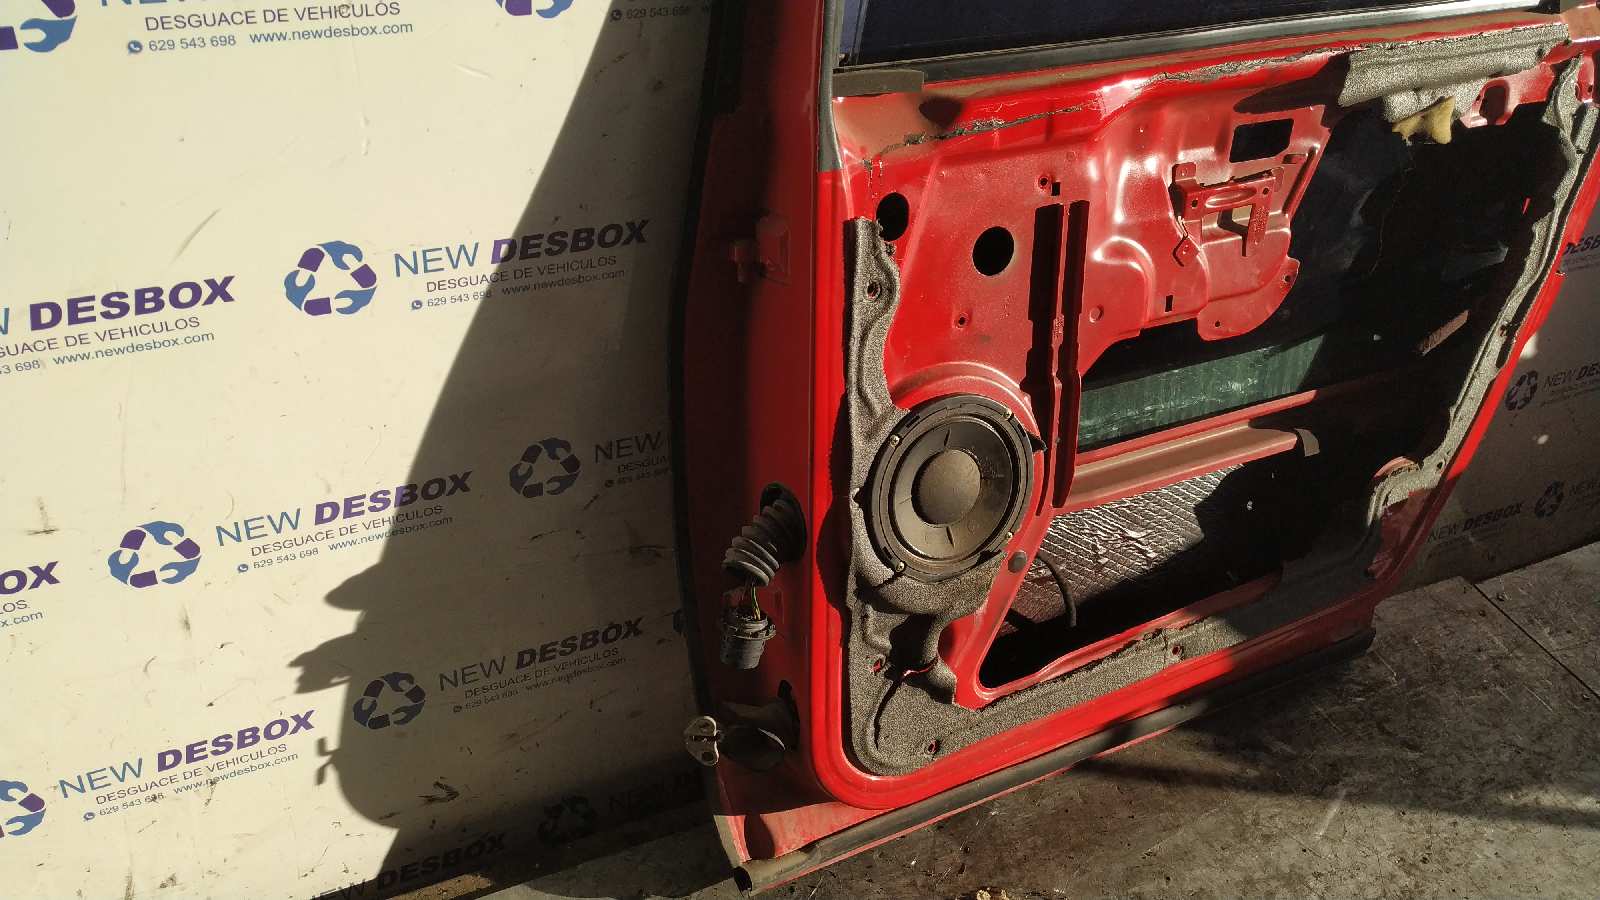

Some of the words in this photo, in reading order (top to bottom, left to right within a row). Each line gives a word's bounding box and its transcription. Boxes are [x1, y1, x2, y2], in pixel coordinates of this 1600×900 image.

[145, 10, 256, 31] DESGUACE
[263, 8, 289, 23] DE
[294, 1, 401, 21] VEHICULOS
[149, 39, 176, 51] 629
[180, 37, 206, 50] 543
[210, 35, 237, 47] 698
[250, 22, 414, 43] www.newdesbox.com
[394, 242, 479, 278] NEW
[491, 219, 649, 264] DESBOX
[426, 271, 510, 293] DESGUACE
[513, 267, 534, 281] DE
[536, 255, 618, 276] VEHICULOS
[29, 275, 236, 332] DESBOX
[427, 296, 448, 307] 629
[450, 293, 470, 304] 543
[15, 360, 41, 373] 698
[53, 332, 216, 366] www.newdesbox.com
[64, 332, 92, 347] DE
[94, 316, 201, 342] VEHICULOS
[595, 431, 662, 464] NEW
[215, 507, 301, 547] NEW
[314, 470, 473, 526] DESBOX
[251, 529, 335, 557] DESGUACE
[338, 523, 359, 537] DE
[362, 504, 444, 531] VEHICULOS
[253, 557, 274, 569] 629
[276, 553, 297, 564] 543
[299, 547, 319, 559] 698
[438, 655, 507, 692] NEW
[515, 616, 645, 670] DESBOX
[58, 757, 143, 799] NEW
[157, 709, 315, 773] DESBOX
[96, 773, 180, 805] DESGUACE
[183, 767, 204, 781] DE
[206, 743, 288, 773] VEHICULOS
[99, 805, 120, 816] 629
[122, 798, 143, 810] 543
[174, 752, 299, 794] www.newdesbox.com
